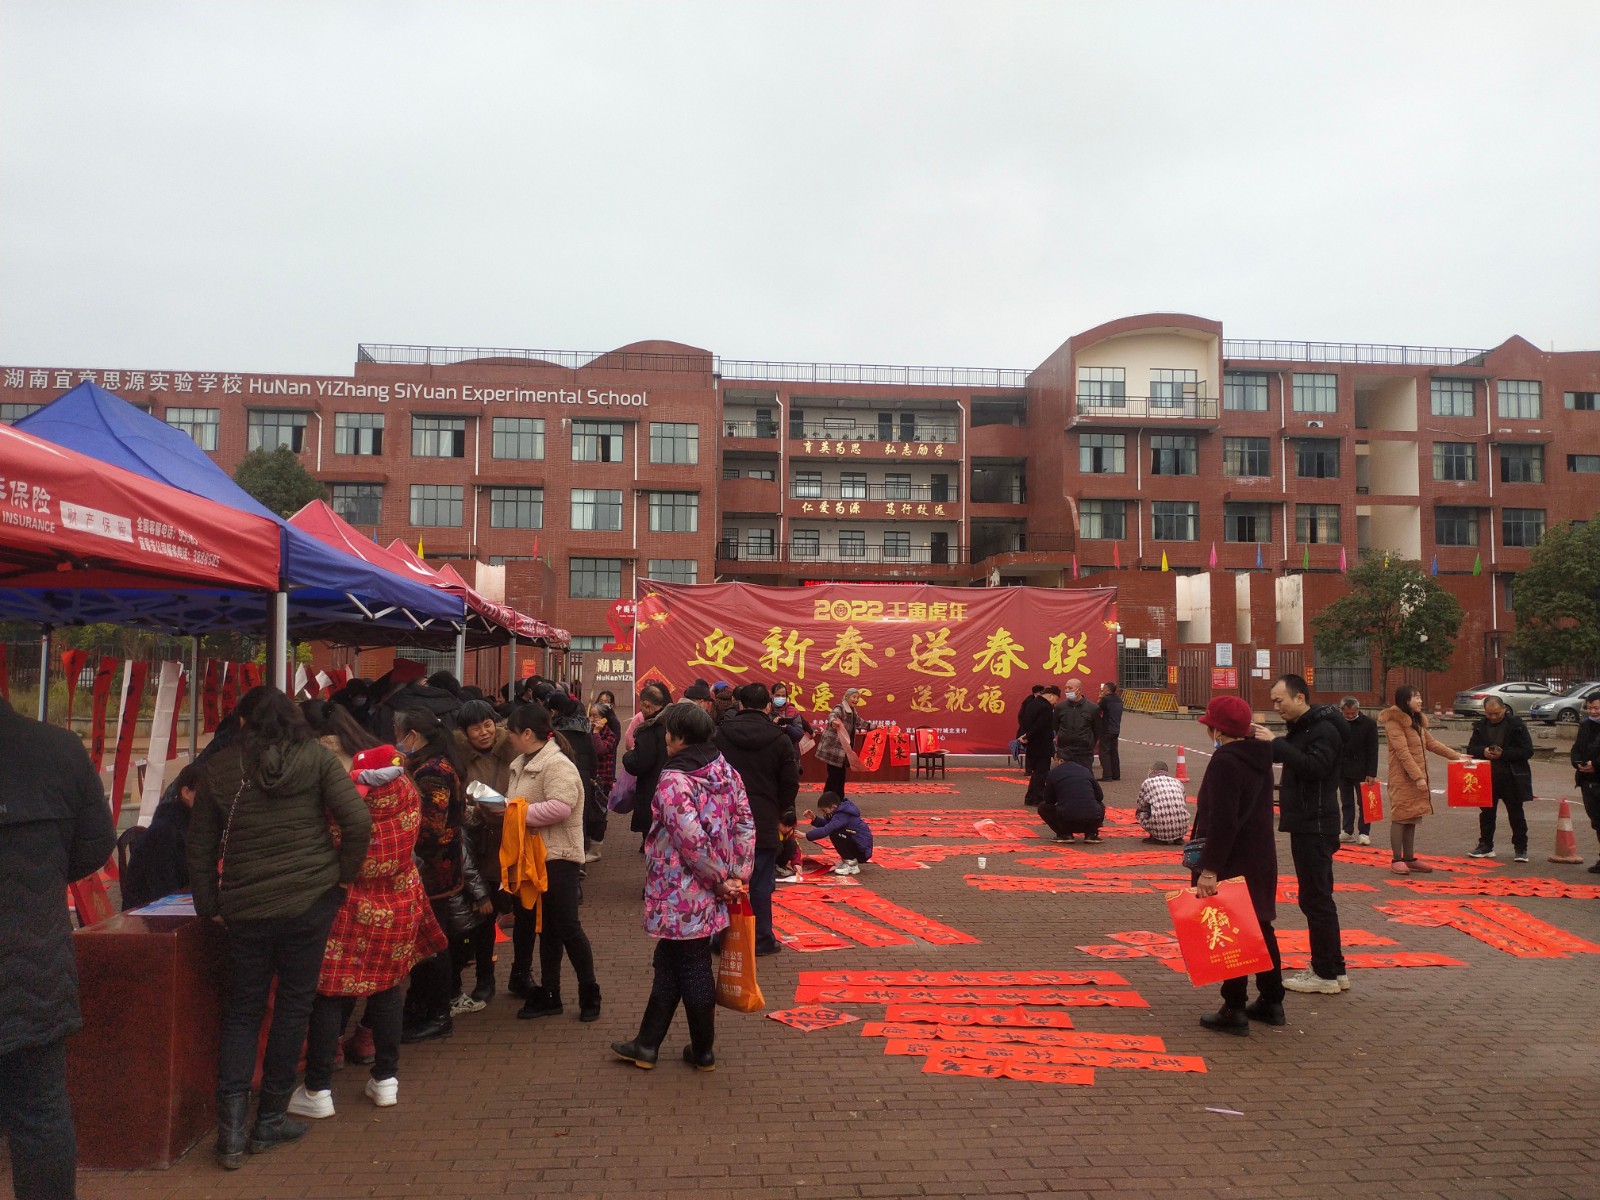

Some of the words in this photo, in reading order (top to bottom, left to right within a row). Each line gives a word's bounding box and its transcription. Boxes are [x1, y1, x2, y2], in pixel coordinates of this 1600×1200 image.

[250, 378, 311, 395] HuNan
[316, 380, 389, 402] YiZhang
[394, 382, 457, 400] SiYuan
[462, 385, 583, 405] Experimental
[587, 389, 649, 407] School
[2, 510, 56, 534] INSURANCE
[813, 600, 884, 621] 2022
